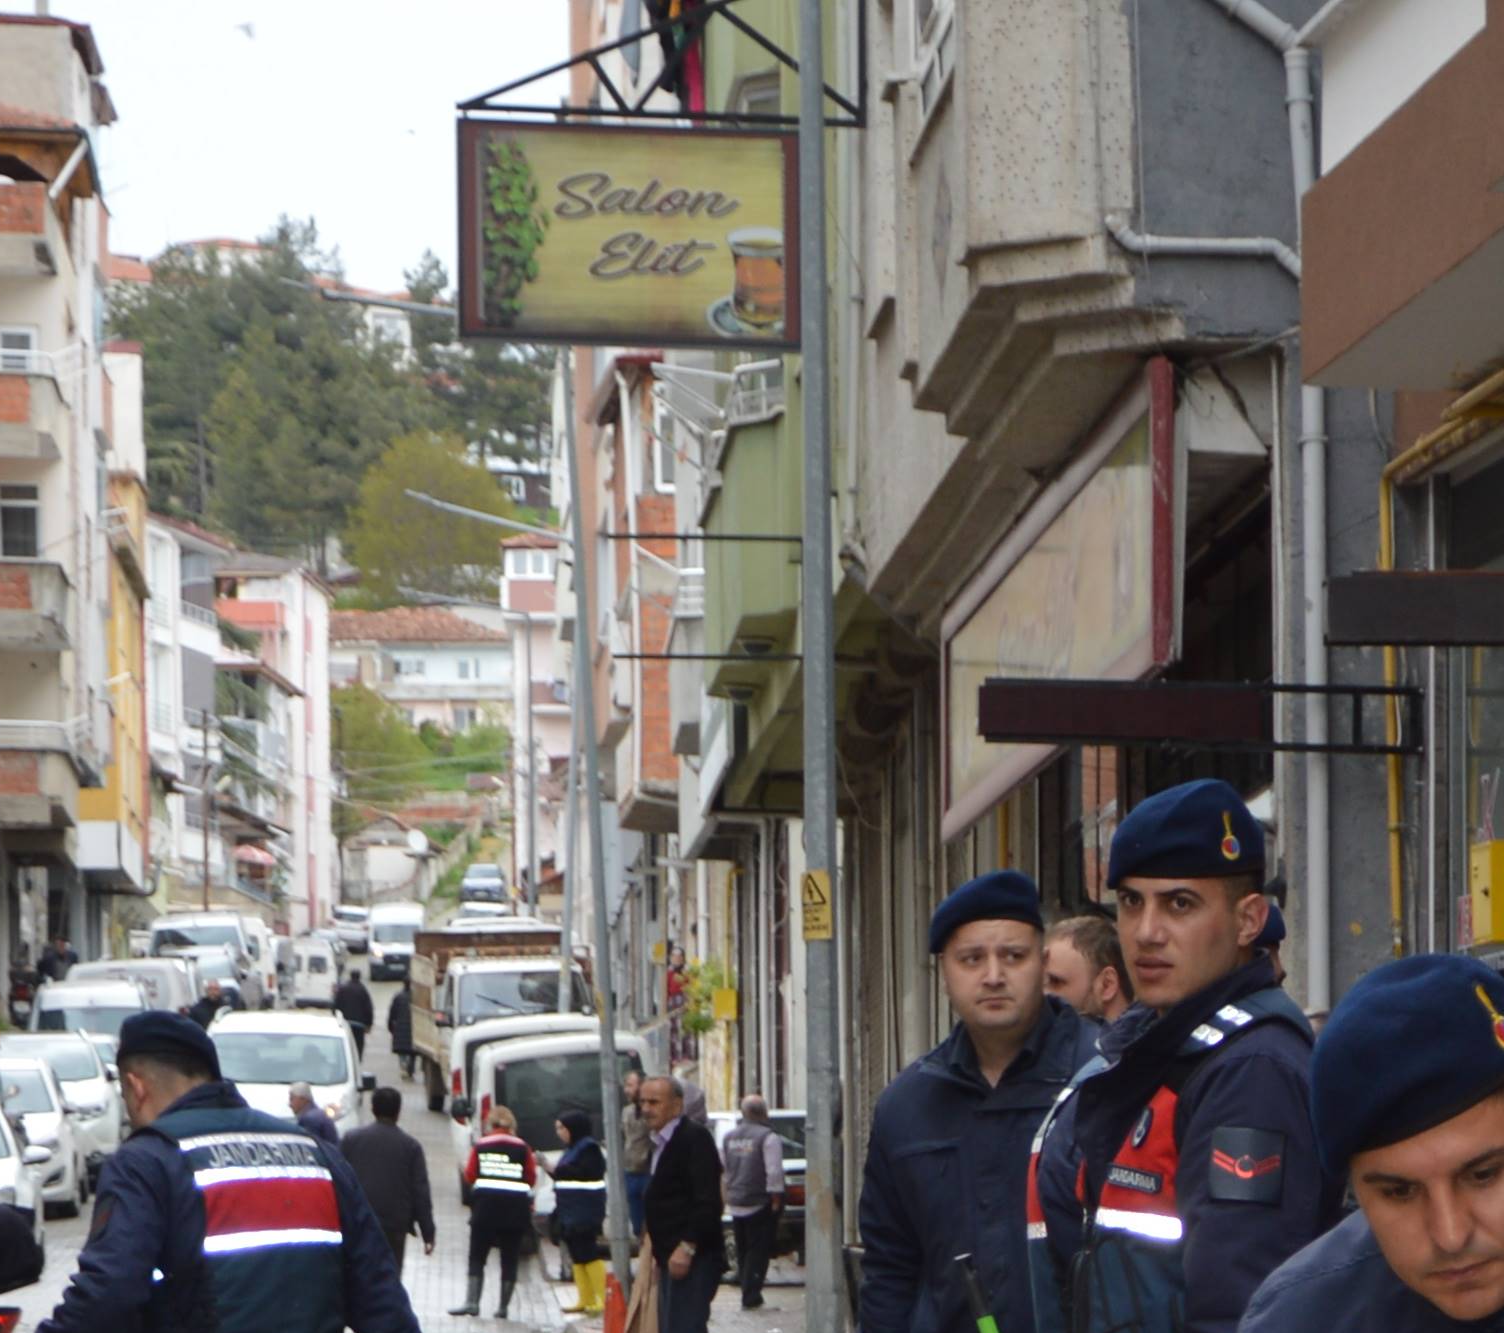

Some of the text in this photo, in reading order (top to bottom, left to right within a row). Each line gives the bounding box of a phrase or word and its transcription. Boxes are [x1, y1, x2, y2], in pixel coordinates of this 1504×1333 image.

[554, 172, 739, 219] Salon
[589, 231, 716, 280] Elit
[209, 1142, 319, 1168] JANDARMA
[1108, 1167, 1156, 1191] JANDARMA
